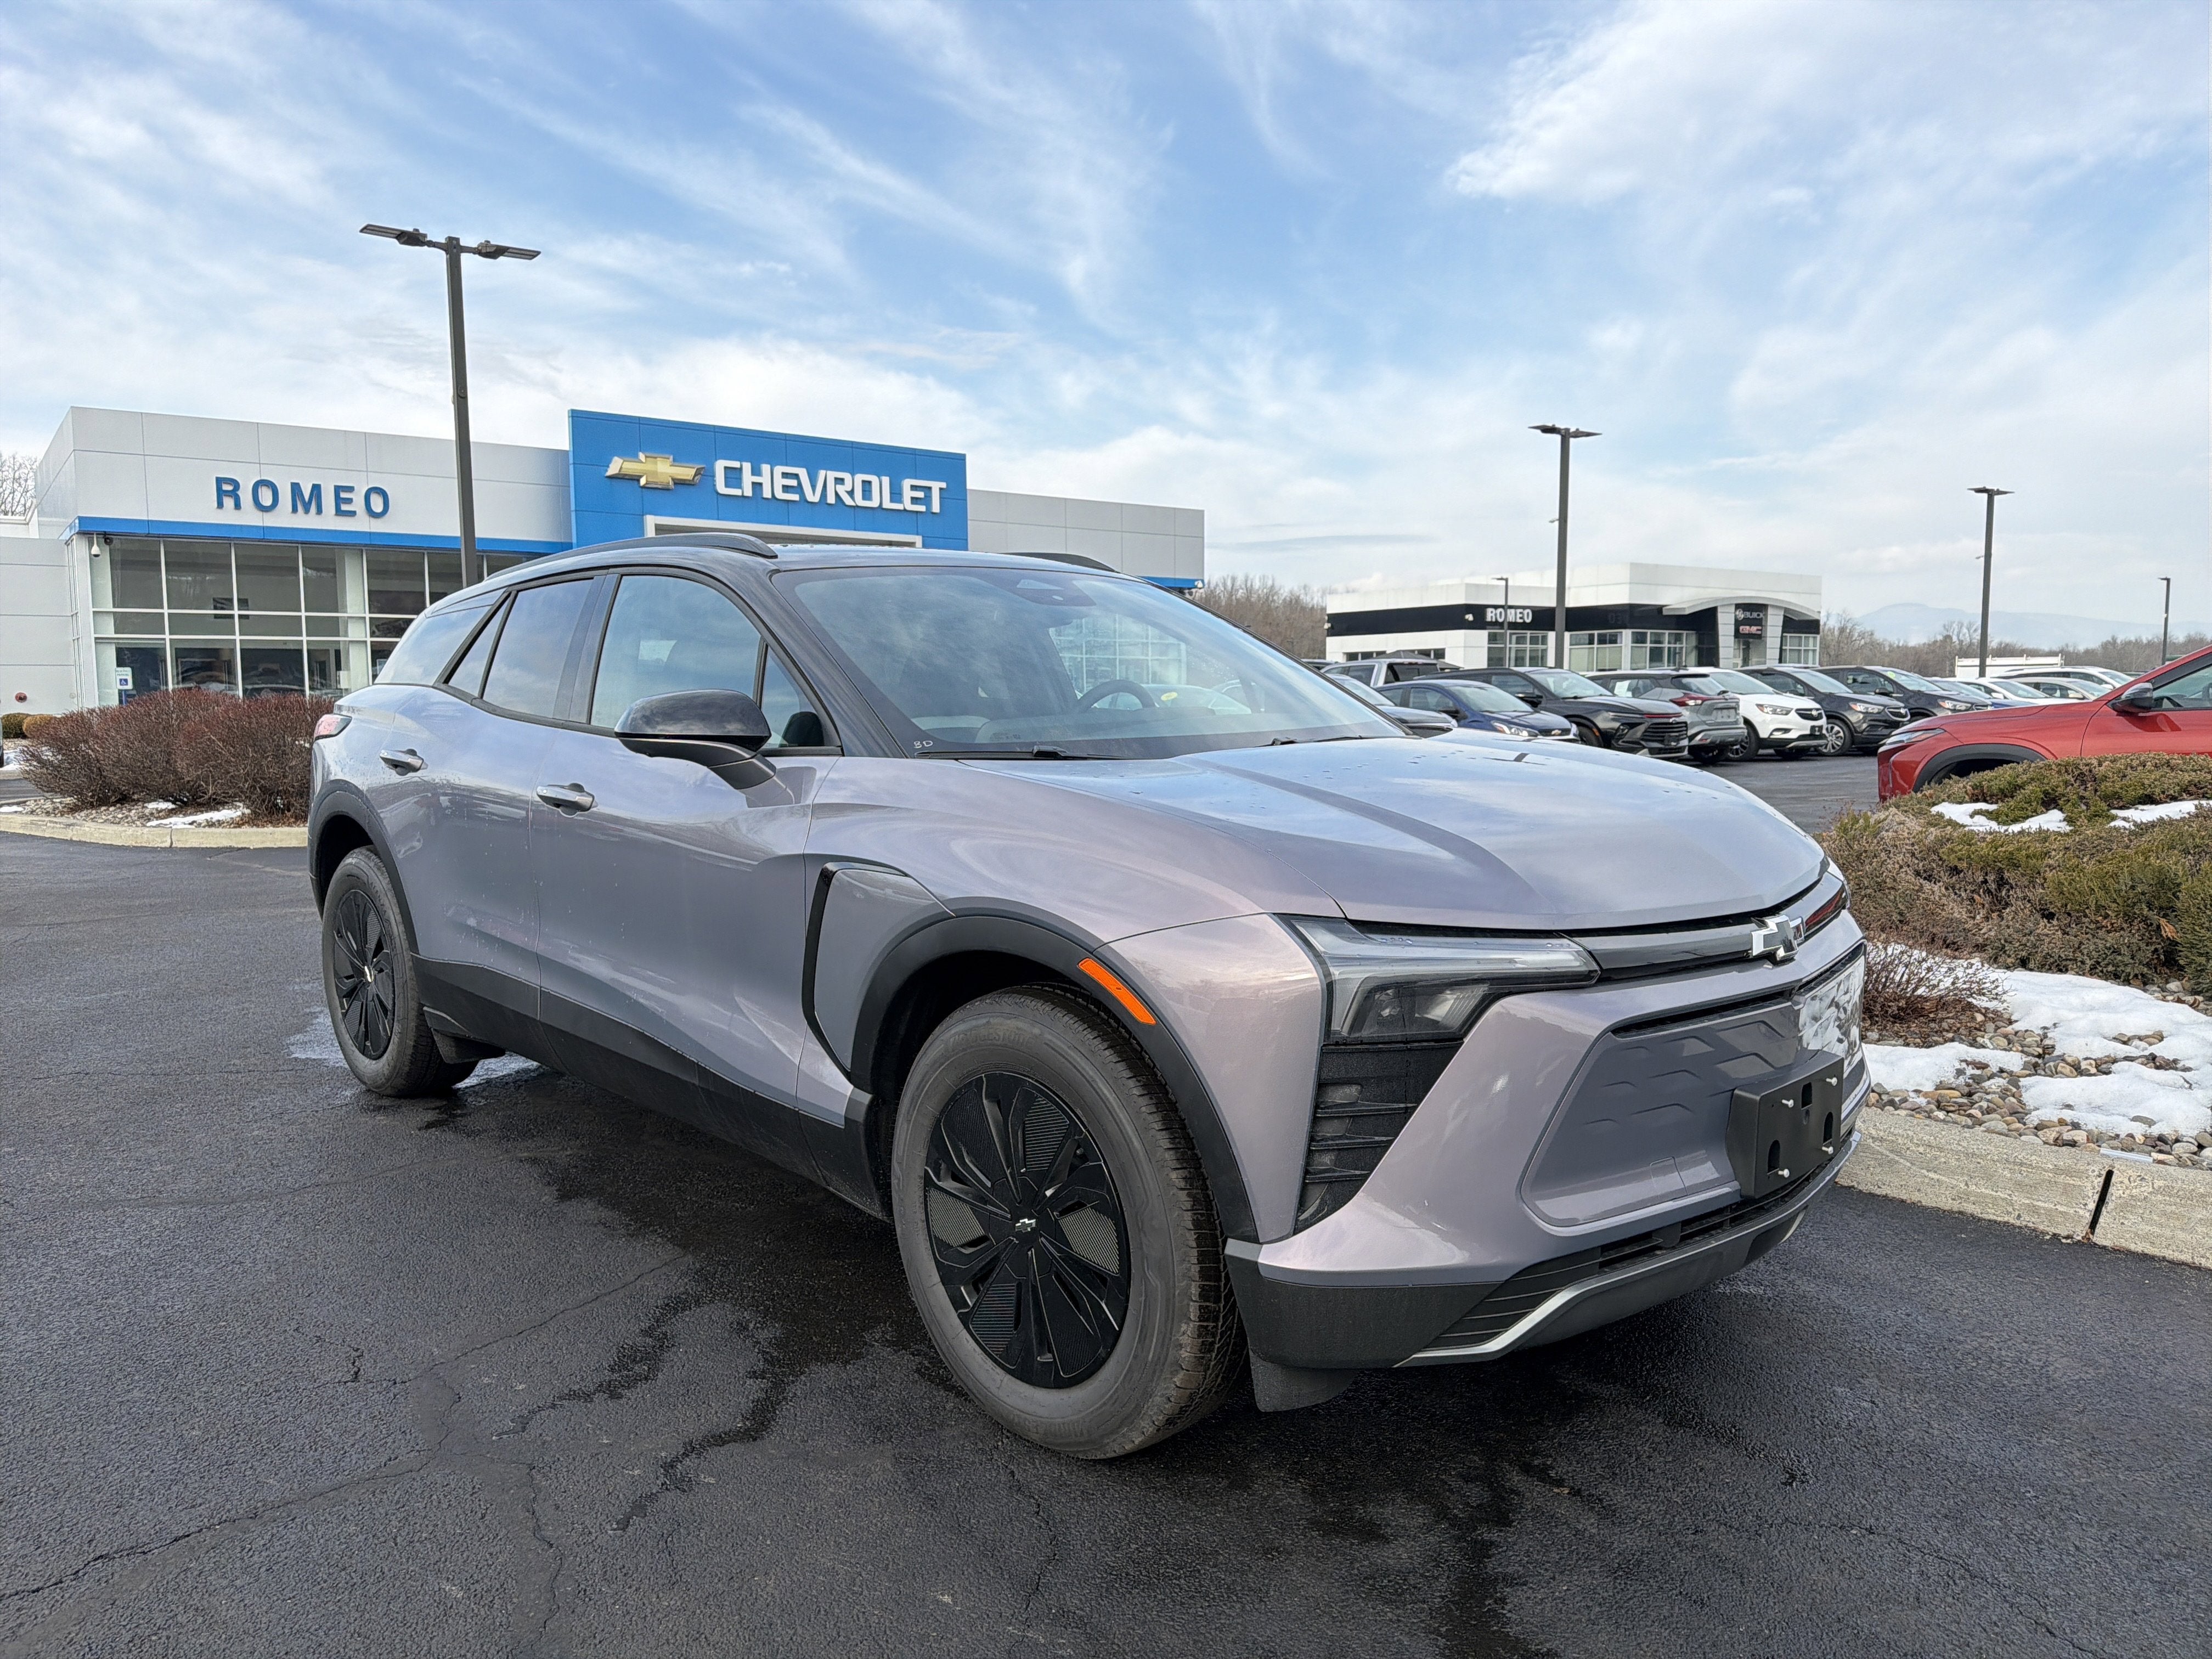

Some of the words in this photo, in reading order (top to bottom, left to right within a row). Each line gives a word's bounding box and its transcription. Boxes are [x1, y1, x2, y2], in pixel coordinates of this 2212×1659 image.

[215, 476, 390, 518] ROMEO
[715, 459, 947, 514] CHEVROLET
[1486, 607, 1532, 623] ROMEO
[1740, 626, 1762, 634] GMC
